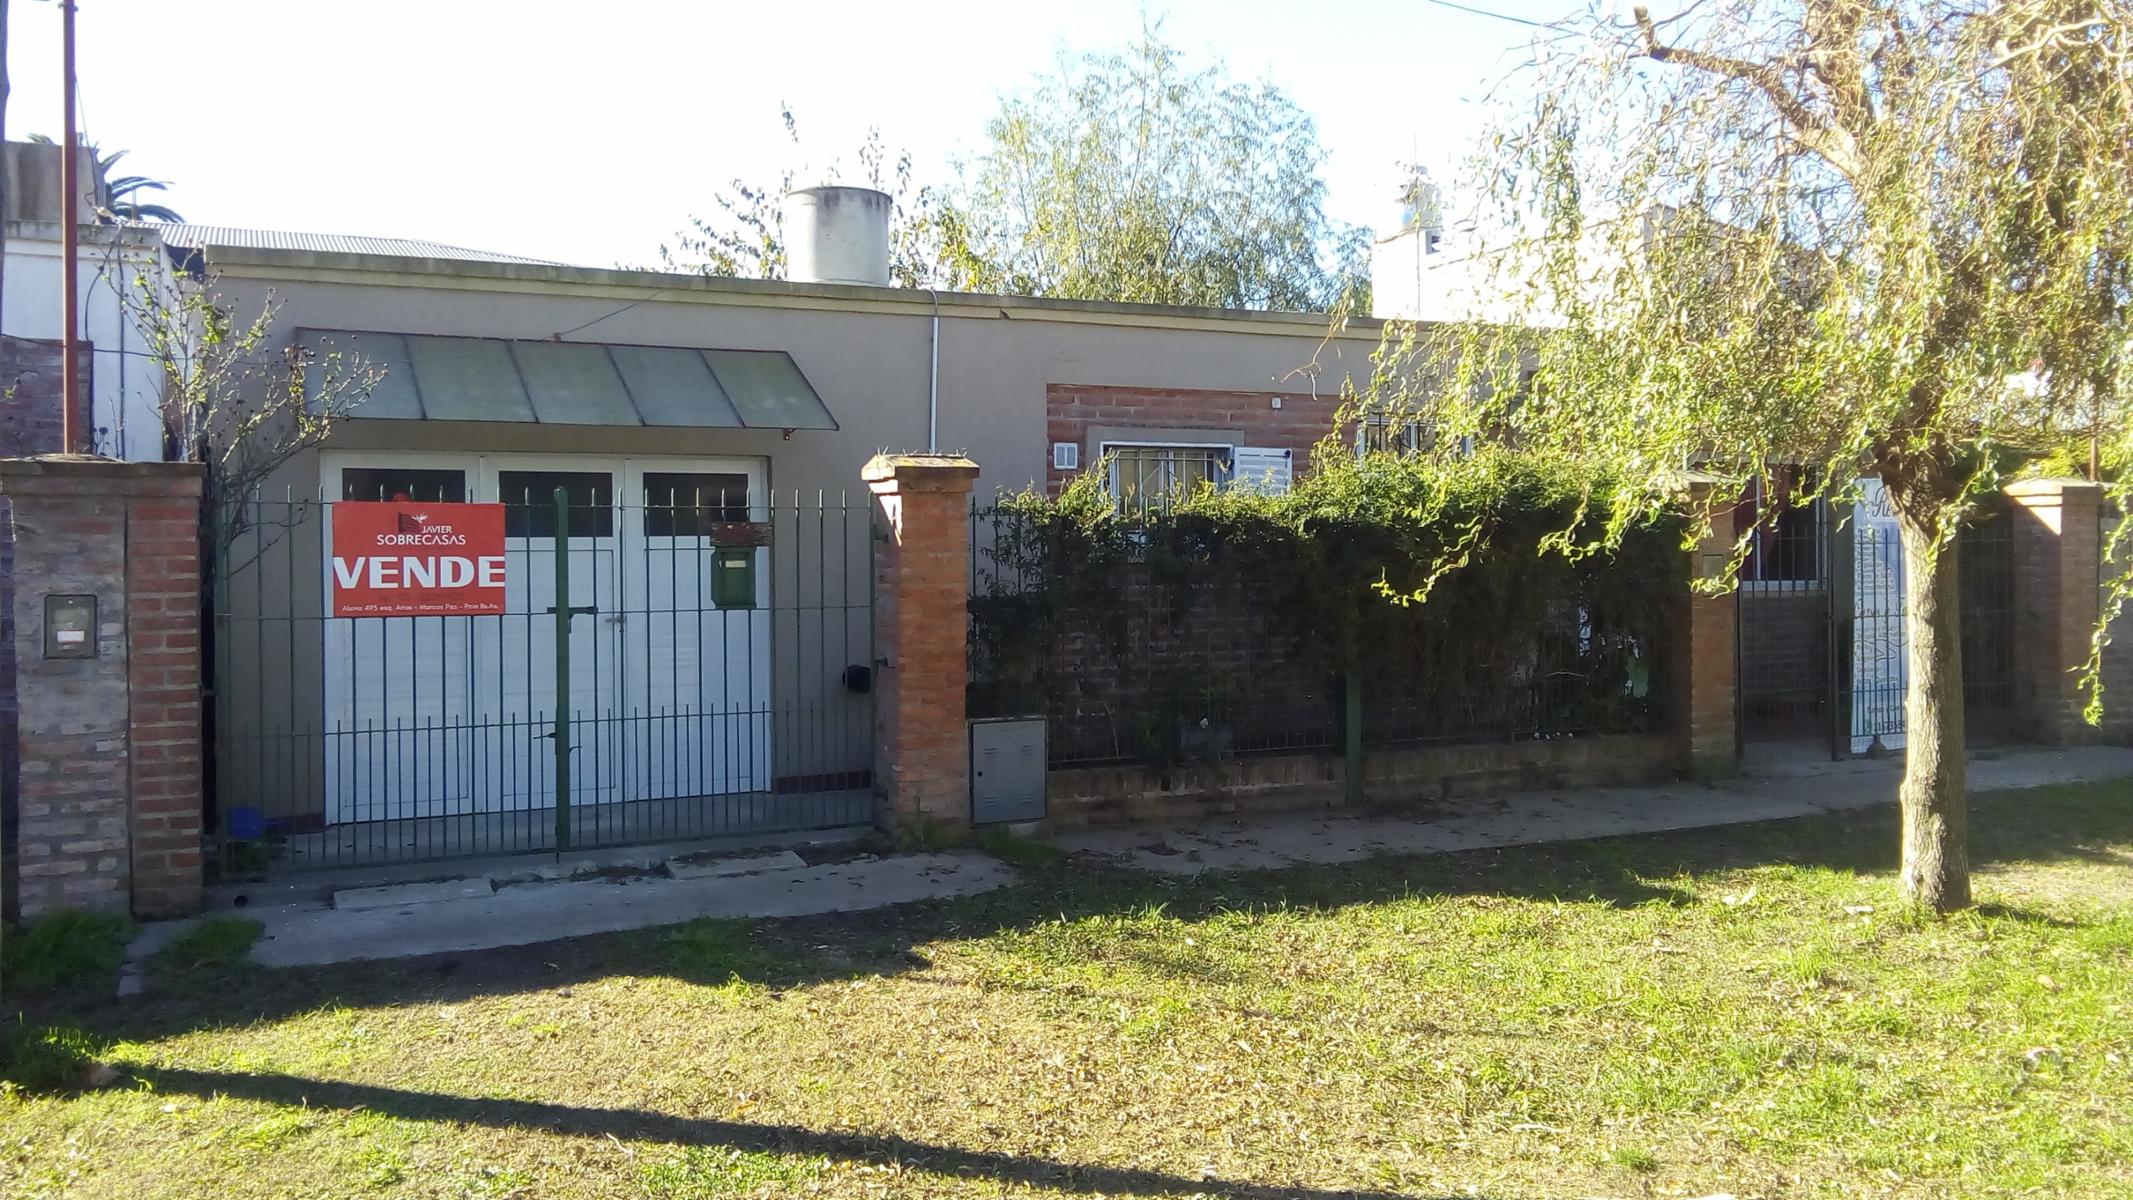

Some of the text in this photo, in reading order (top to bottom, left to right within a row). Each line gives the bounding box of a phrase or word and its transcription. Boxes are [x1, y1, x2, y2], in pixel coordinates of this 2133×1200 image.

[421, 525, 453, 534] JAVIER
[377, 534, 466, 546] SOBRECASAS
[333, 556, 505, 589] VENDE
